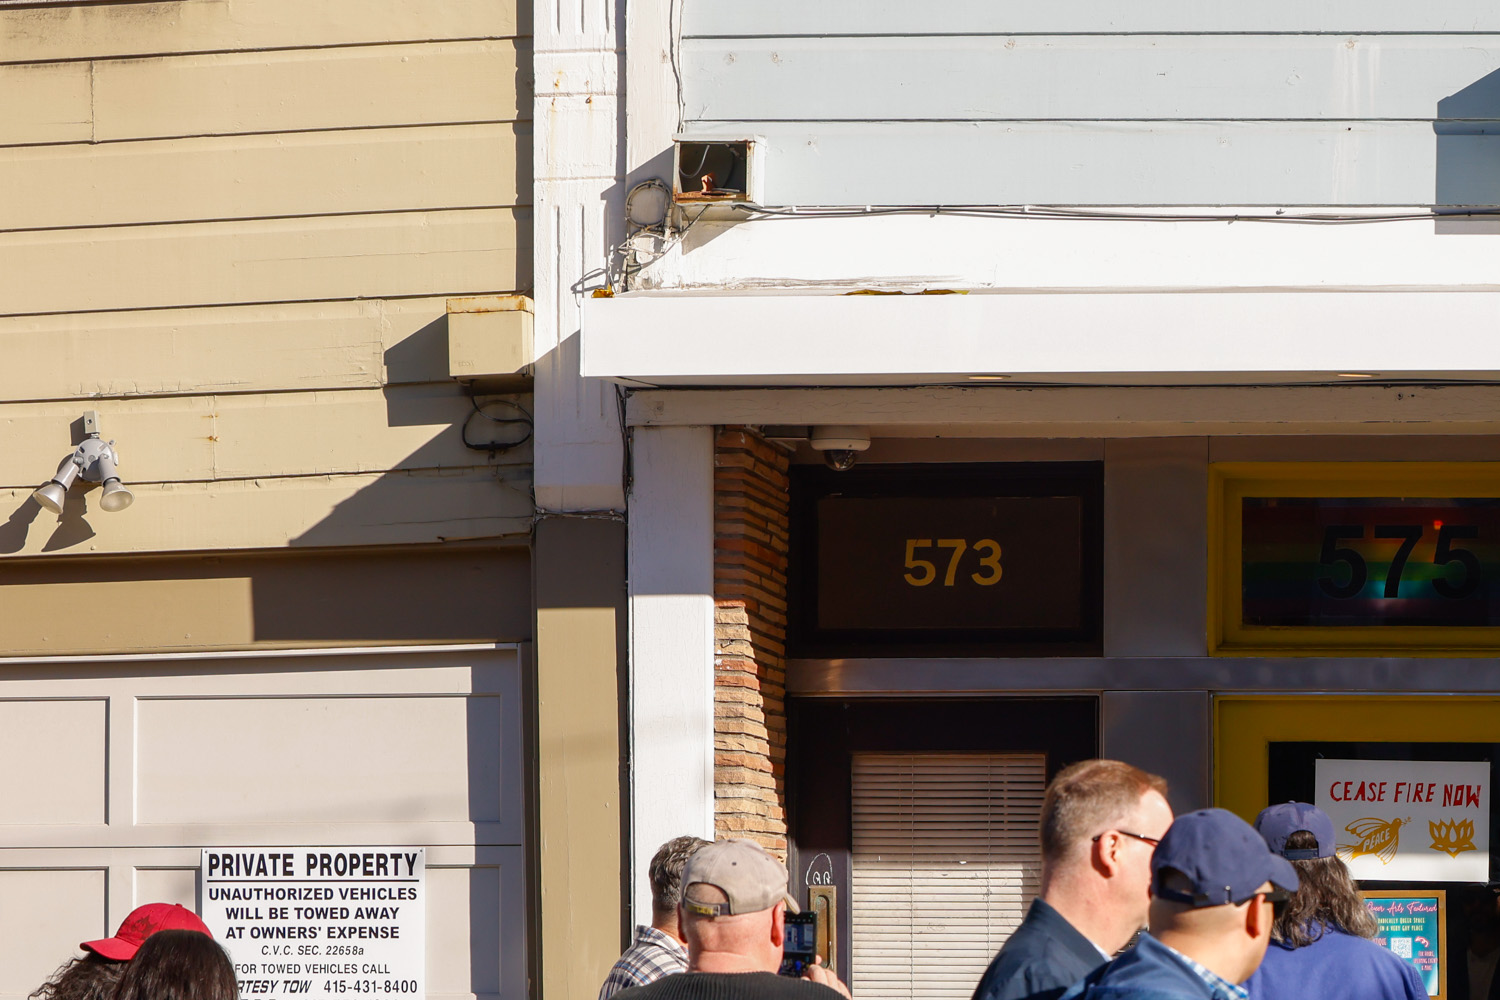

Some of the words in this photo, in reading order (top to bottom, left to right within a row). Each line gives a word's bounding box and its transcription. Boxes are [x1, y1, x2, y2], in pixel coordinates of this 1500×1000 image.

[904, 538, 1003, 587] 573
[1318, 525, 1481, 599] 575
[1330, 781, 1387, 802] CEASE
[1394, 782, 1436, 803] FIRE
[1442, 784, 1482, 808] NOW
[1362, 828, 1391, 852] PEACE
[208, 853, 294, 876] PRIVATE
[306, 853, 418, 876] PROPERTY
[208, 888, 334, 900] UNAUTHORIZED
[339, 888, 417, 900] VEHICLES
[226, 907, 263, 919] WILL
[268, 907, 289, 919] BE
[294, 907, 350, 919] TOWED
[354, 907, 400, 919] AWAY
[1387, 902, 1404, 916] Arts
[1407, 901, 1437, 915] Featured
[226, 927, 245, 939] AT
[250, 927, 322, 939] OWNERS'
[327, 927, 399, 939] EXPENSE
[261, 945, 293, 956] C.V.C.
[297, 945, 322, 956] SEC.
[326, 945, 364, 956] 22658a
[235, 964, 257, 974] FOR
[261, 964, 301, 974] TOWED
[305, 964, 358, 974] VEHICLES
[362, 964, 391, 974] CALL
[238, 980, 278, 993] RTESY
[282, 980, 312, 993] TOW
[323, 980, 418, 993] 415-431-8400
